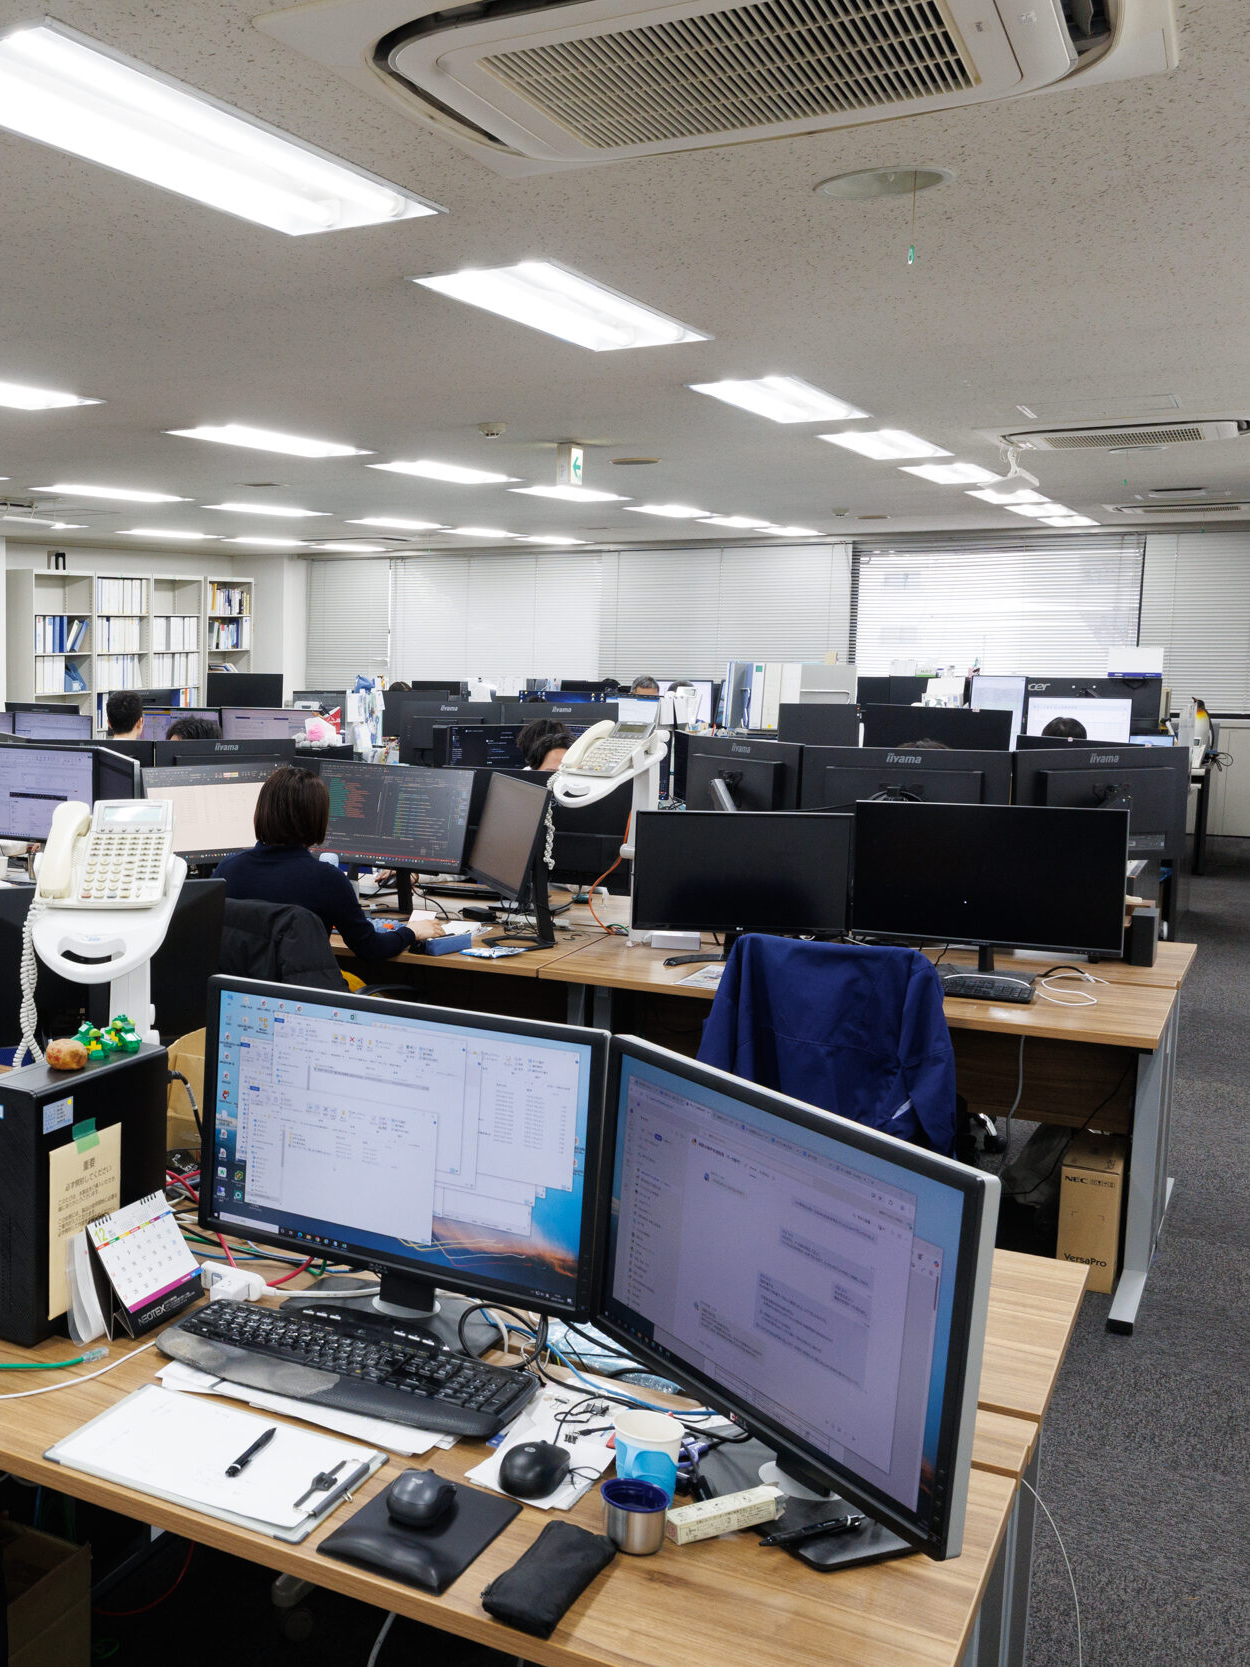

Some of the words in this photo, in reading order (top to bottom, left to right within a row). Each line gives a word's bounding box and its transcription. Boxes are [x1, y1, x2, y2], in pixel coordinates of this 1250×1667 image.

[1028, 683, 1050, 691] cer
[214, 742, 239, 751] iiyama
[886, 752, 922, 764] iiyama
[1089, 752, 1120, 764] iiyama
[1064, 1175, 1088, 1185] NEC
[94, 1228, 109, 1243] 12
[1064, 1253, 1108, 1268] VersaPro
[138, 1303, 167, 1327] NEOTEX
